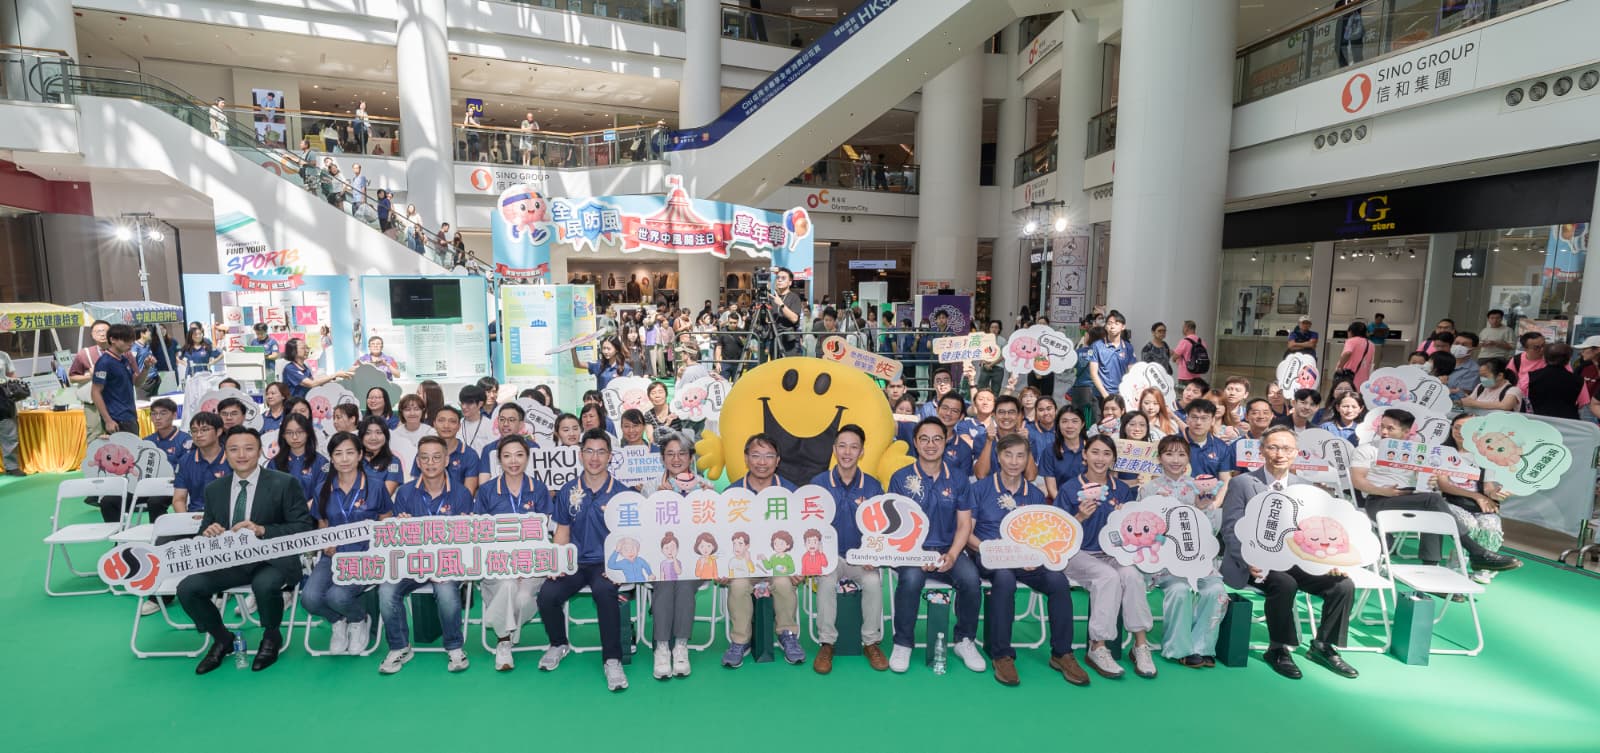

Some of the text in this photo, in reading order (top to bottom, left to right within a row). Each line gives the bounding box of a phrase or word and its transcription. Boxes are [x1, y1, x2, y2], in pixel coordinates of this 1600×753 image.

[1378, 42, 1475, 82] SINO GROUP
[1376, 68, 1452, 104] 信和集團
[495, 171, 550, 181] SINO GROUP
[552, 201, 622, 240] 全民防風
[734, 213, 786, 247] 嘉年華
[1371, 222, 1396, 231] store
[638, 228, 715, 246] 世界中風關注日
[226, 244, 266, 256] FIND YOUR
[227, 248, 300, 273] SPORTS
[14, 313, 80, 329] 多方位健康檢查
[874, 360, 896, 378] 快
[1430, 422, 1446, 440] 定期
[532, 449, 578, 469] HKU
[627, 448, 645, 457] HKU
[1527, 448, 1559, 479] 戒煙限酒
[1112, 457, 1163, 474] 健康飲食
[535, 468, 578, 486] Med
[617, 496, 825, 527] 重視談笑用兵
[1264, 498, 1284, 542] 充足睡眠
[373, 517, 545, 547] 戒煙限酒控三高
[1179, 511, 1195, 552] 控制血壓
[165, 532, 250, 560] 香港中風學會
[166, 525, 371, 574] THE HONG KONG STROKE SOCIETY
[851, 552, 877, 562] Standing
[878, 553, 893, 561] with
